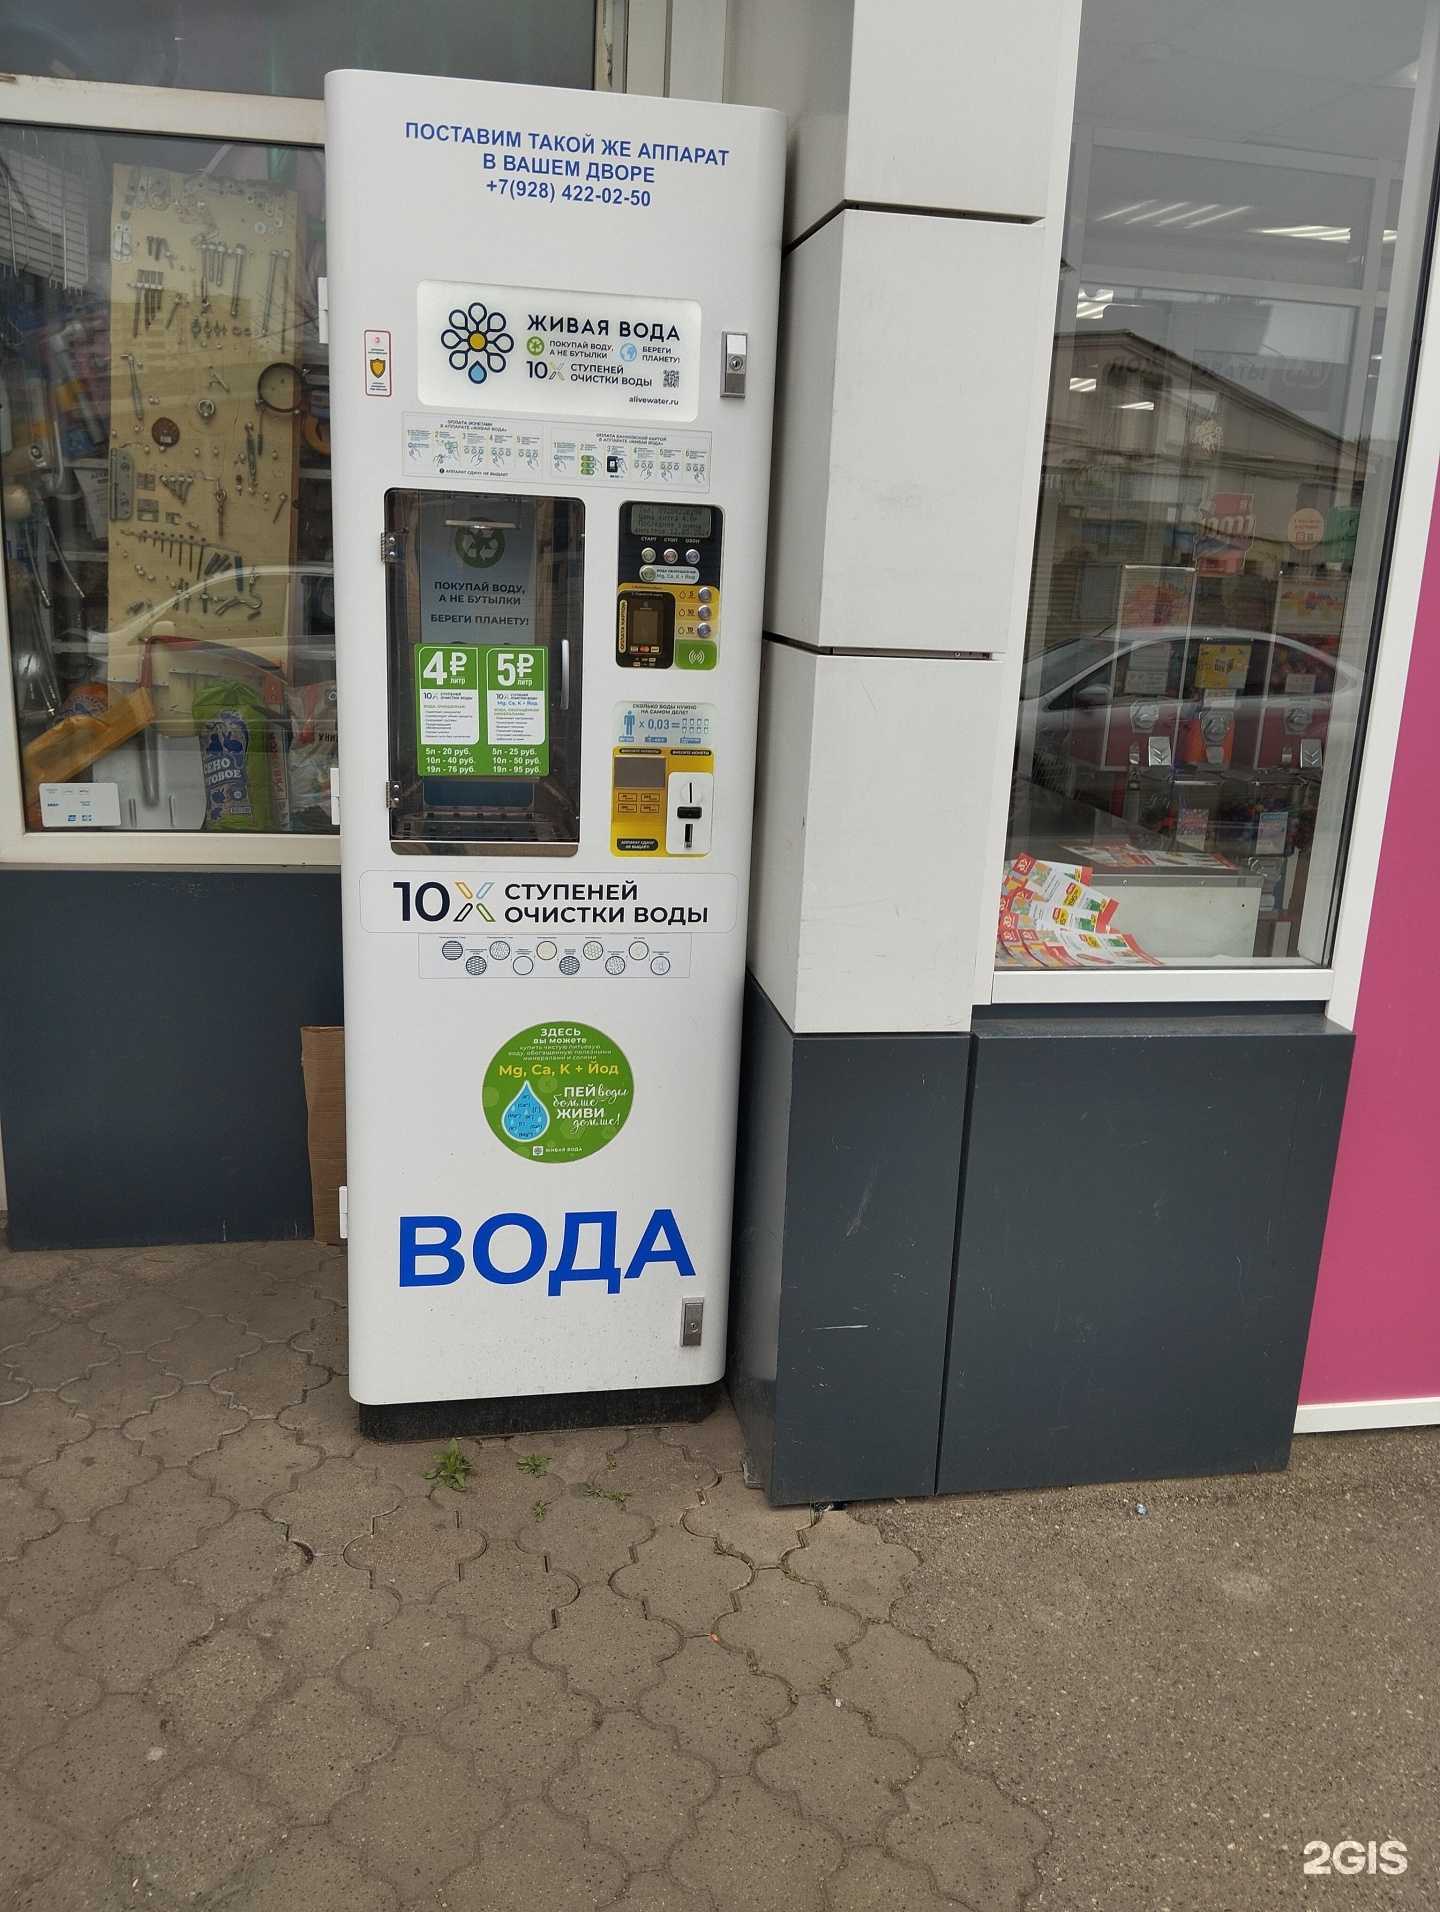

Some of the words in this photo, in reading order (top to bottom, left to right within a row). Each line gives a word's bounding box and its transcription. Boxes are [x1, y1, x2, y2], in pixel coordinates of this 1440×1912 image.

[405, 122, 521, 148] ПОСТАВИМ
[528, 131, 595, 154] ТАКОЙ
[601, 139, 632, 158] ЖЕ
[638, 143, 729, 166] АППАРАТ
[483, 153, 497, 170] В
[503, 156, 580, 177] ВАШЕМ
[587, 162, 655, 183] ДВОРЕ
[486, 178, 556, 202] +7(928)
[562, 185, 651, 207] 422-02-50
[527, 314, 609, 336] ЖИВАЯ
[619, 321, 680, 342] ВОДА
[550, 340, 589, 350] ПОКУПАЙ
[591, 343, 614, 352] ВОДУ,
[642, 346, 671, 354] БЕРЕГИ
[570, 351, 608, 359] БУТЫЛКИ
[571, 363, 624, 374] СТУПЕНЕЙ
[571, 374, 618, 385] ОЧИСТКИ
[621, 377, 652, 387] ВОДЫ
[629, 396, 679, 406] alivewater.ru
[434, 582, 489, 592] ПОКУПАЙ
[493, 584, 525, 594] ВОДУ,
[438, 594, 447, 602] А
[450, 595, 464, 603] НЕ
[468, 596, 521, 605] БУТЫЛКИ
[431, 614, 472, 623] БЕРЕГИ
[475, 616, 529, 626] ПЛАНЕТУ!
[648, 719, 670, 731] 0,03
[454, 748, 471, 757] руб.
[520, 749, 537, 757] руб.
[460, 757, 475, 765] руб.
[525, 757, 541, 766] руб.
[460, 766, 475, 774] руб.
[525, 766, 541, 775] руб.
[504, 880, 638, 901] СТУПЕНЕЙ
[504, 907, 624, 924] ОЧИСТКИ
[633, 907, 709, 926] ВОДЫ
[540, 1028, 582, 1038] ЗДЕСЬ
[499, 1065, 527, 1078] Mg,
[532, 1064, 556, 1077] Ca,
[559, 1064, 571, 1074] K
[575, 1065, 583, 1073] +
[588, 1061, 619, 1076] Йод
[564, 1084, 596, 1098] ПЕЙ
[556, 1107, 605, 1120] ЖИВИ
[399, 1208, 696, 1297] ВОДА
